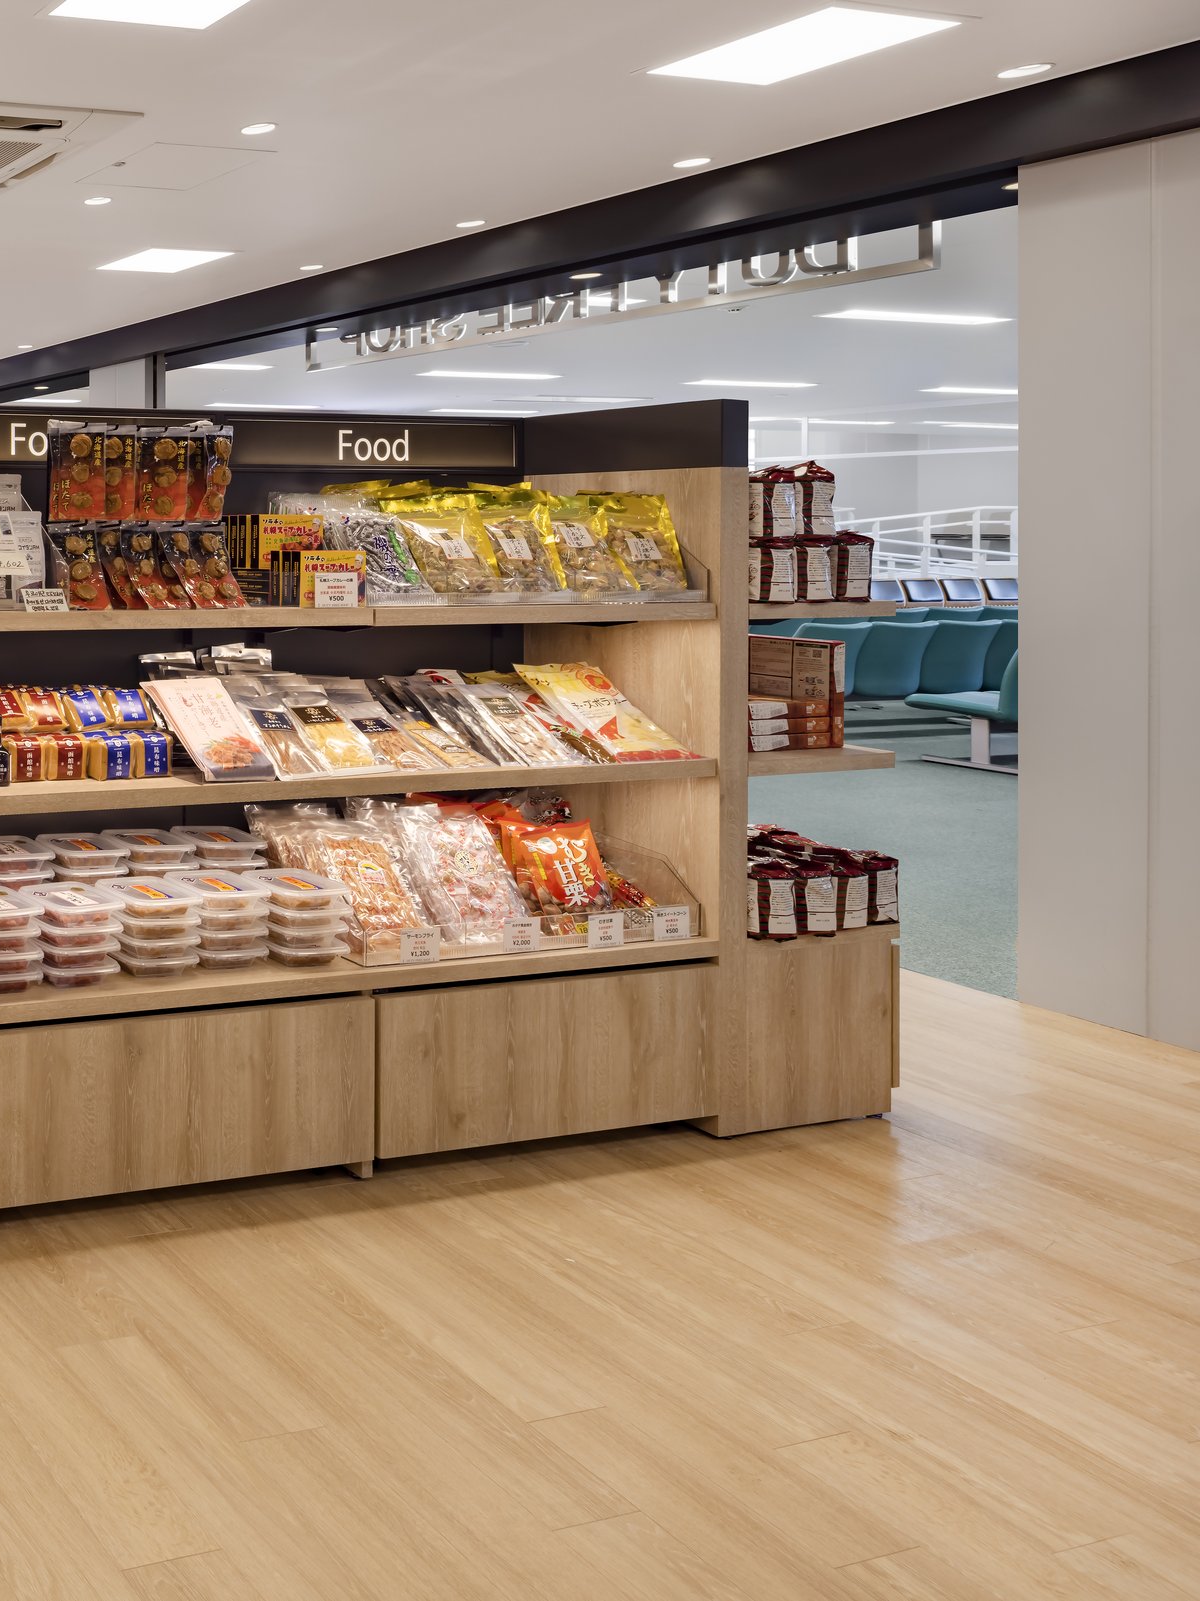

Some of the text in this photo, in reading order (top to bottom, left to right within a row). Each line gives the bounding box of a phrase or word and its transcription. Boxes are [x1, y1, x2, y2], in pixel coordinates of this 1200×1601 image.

[11, 423, 49, 456] Fo
[94, 436, 102, 466] 北海道産
[125, 438, 133, 468] 北海道産
[339, 429, 409, 461] Food
[61, 479, 71, 512] ほたて
[142, 483, 153, 514] ほたて
[556, 837, 596, 887] むき
[553, 857, 590, 907] 甘栗
